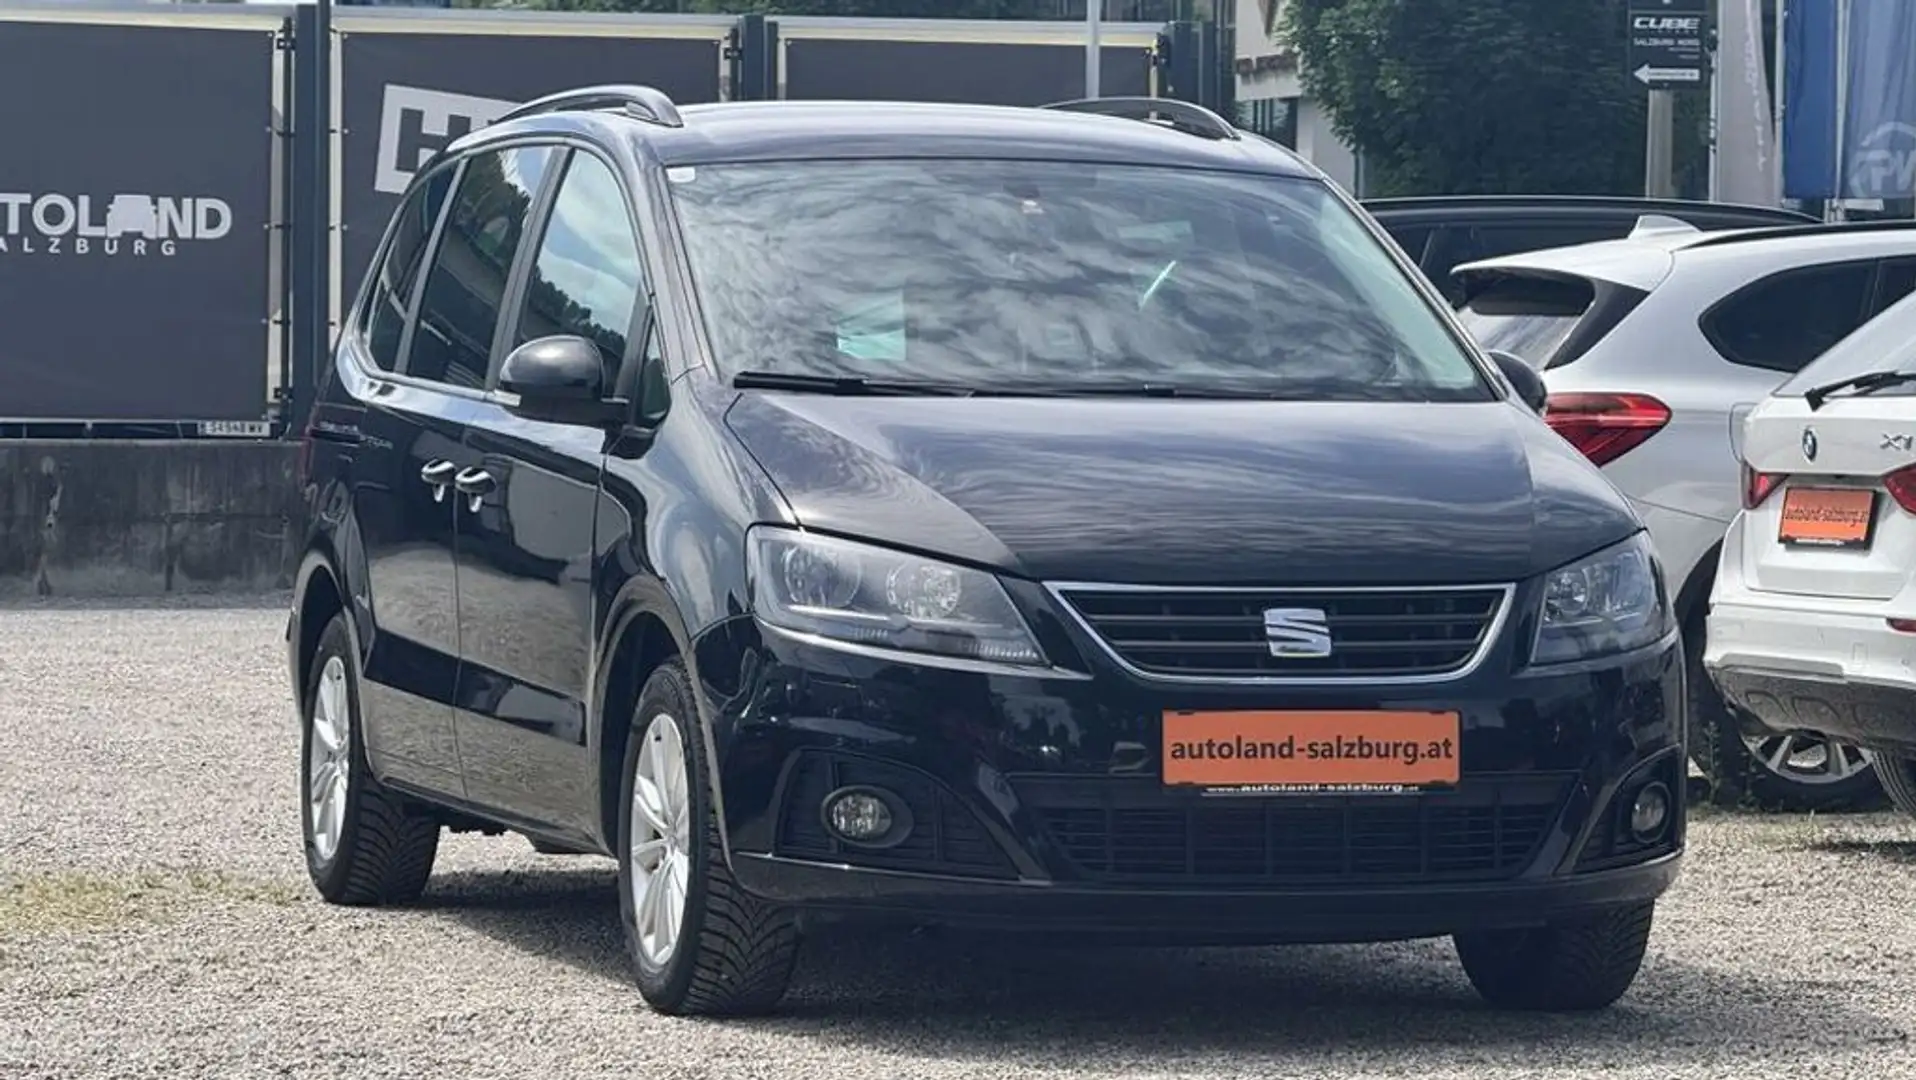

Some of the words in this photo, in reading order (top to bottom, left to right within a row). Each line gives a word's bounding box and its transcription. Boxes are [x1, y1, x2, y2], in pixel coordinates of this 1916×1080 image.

[1633, 16, 1701, 29] CUBE
[1880, 433, 1913, 451] X1
[1170, 735, 1453, 765] autoland-salzburg.at
